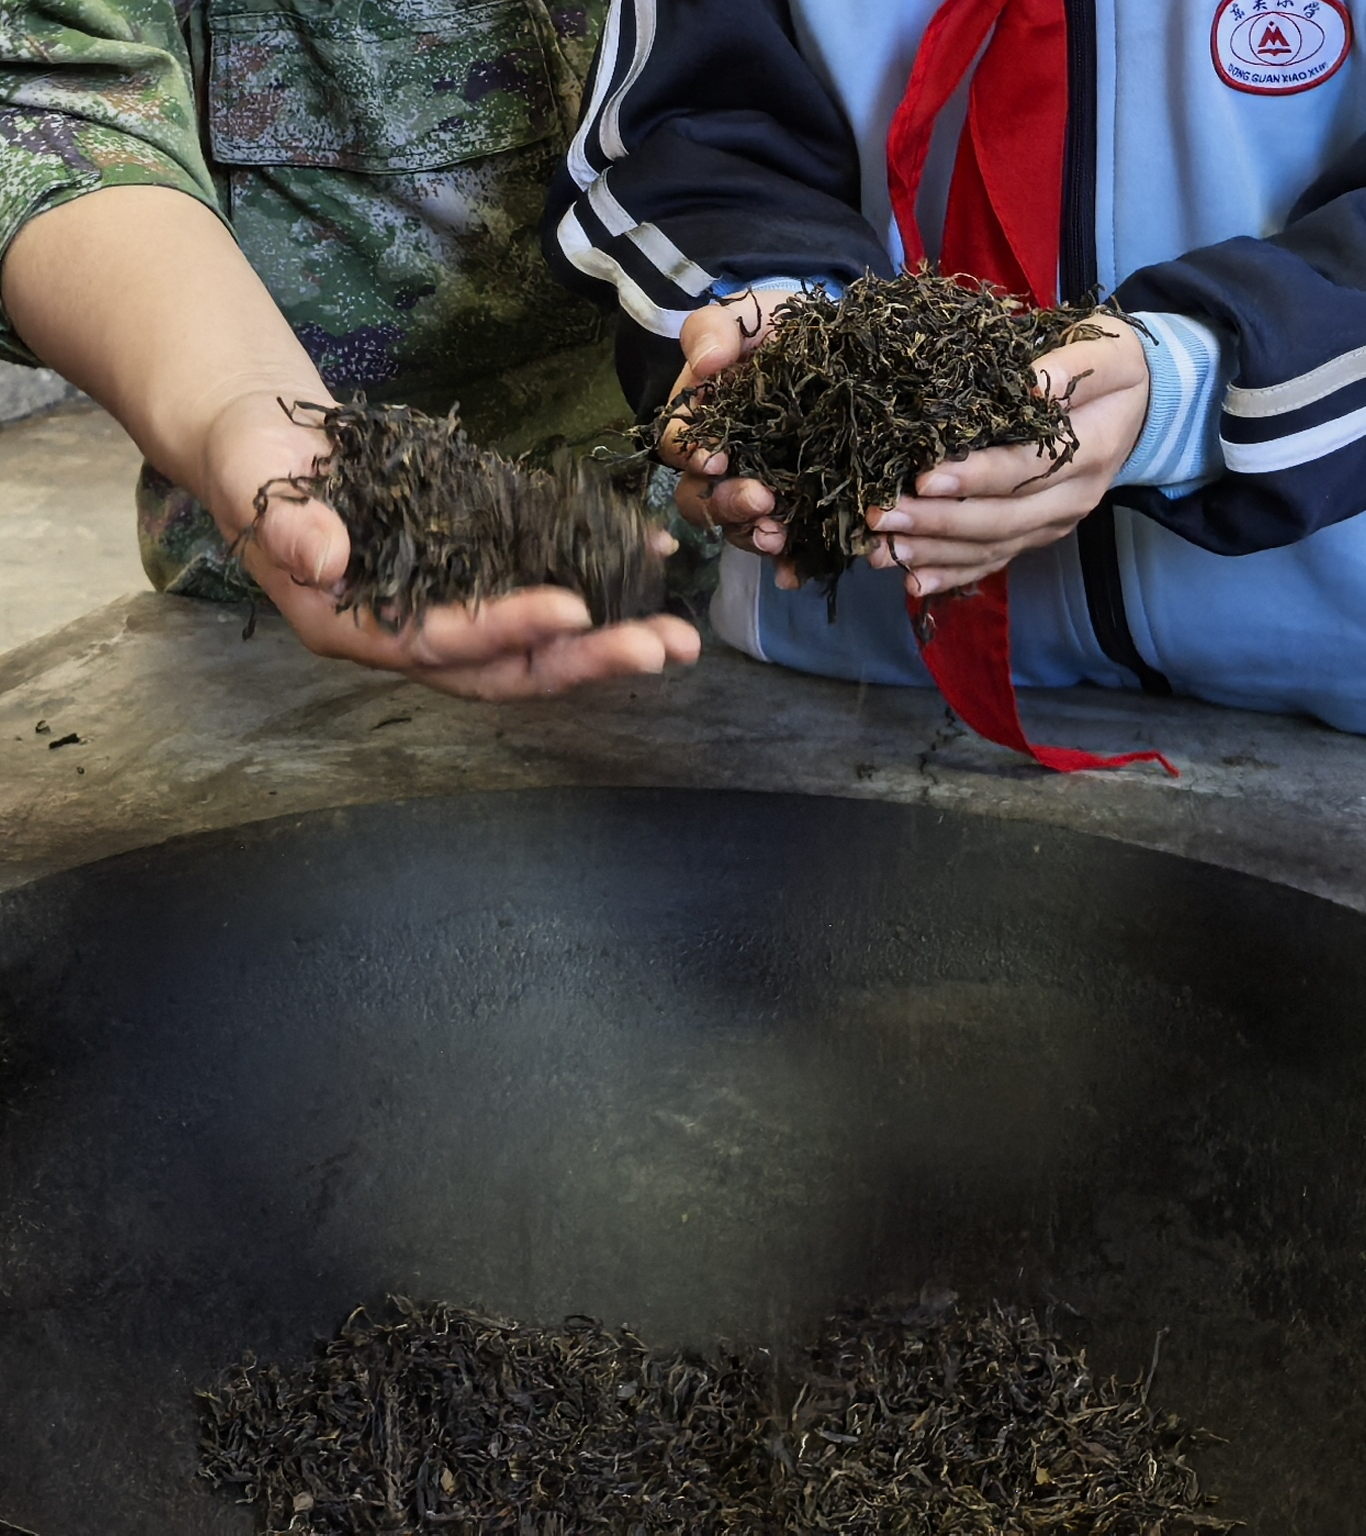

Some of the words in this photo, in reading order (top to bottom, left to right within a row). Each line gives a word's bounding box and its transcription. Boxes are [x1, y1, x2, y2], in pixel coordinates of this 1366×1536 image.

[1227, 62, 1251, 81] DONG
[1251, 73, 1281, 83] GUAN
[1281, 70, 1308, 83] XIAO
